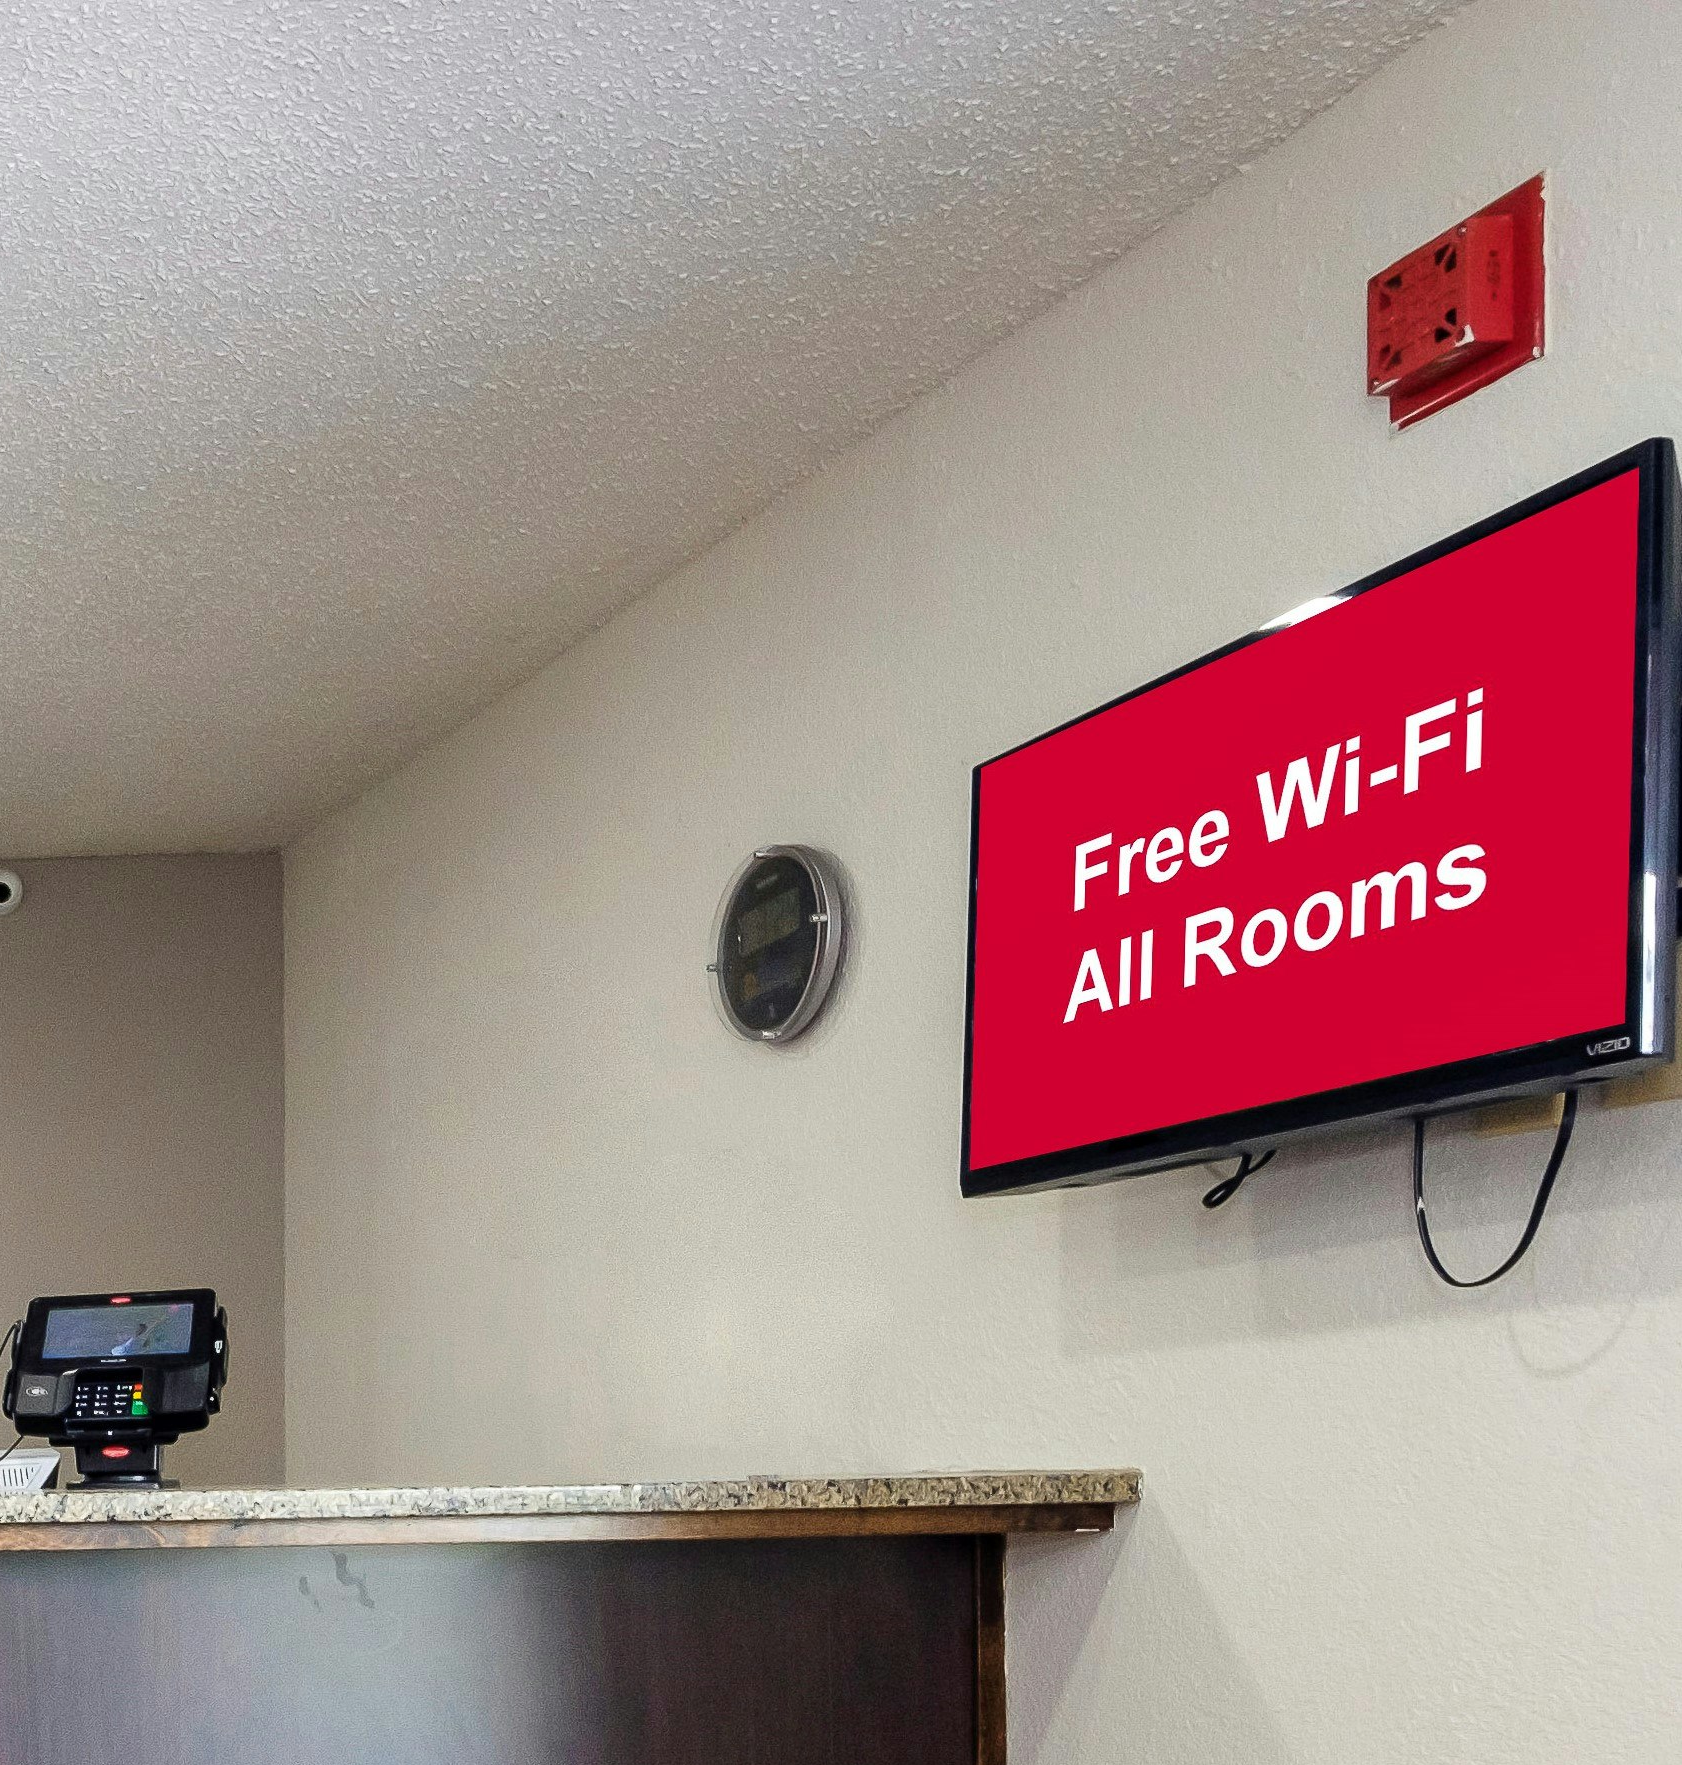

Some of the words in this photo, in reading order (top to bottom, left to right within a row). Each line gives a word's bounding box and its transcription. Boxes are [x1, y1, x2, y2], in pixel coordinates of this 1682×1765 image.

[1073, 809, 1230, 912] Free
[1255, 687, 1484, 843] Wi-Fi
[1062, 928, 1154, 1024] All
[1183, 843, 1487, 989] Rooms
[1586, 1036, 1631, 1056] VIZIO
